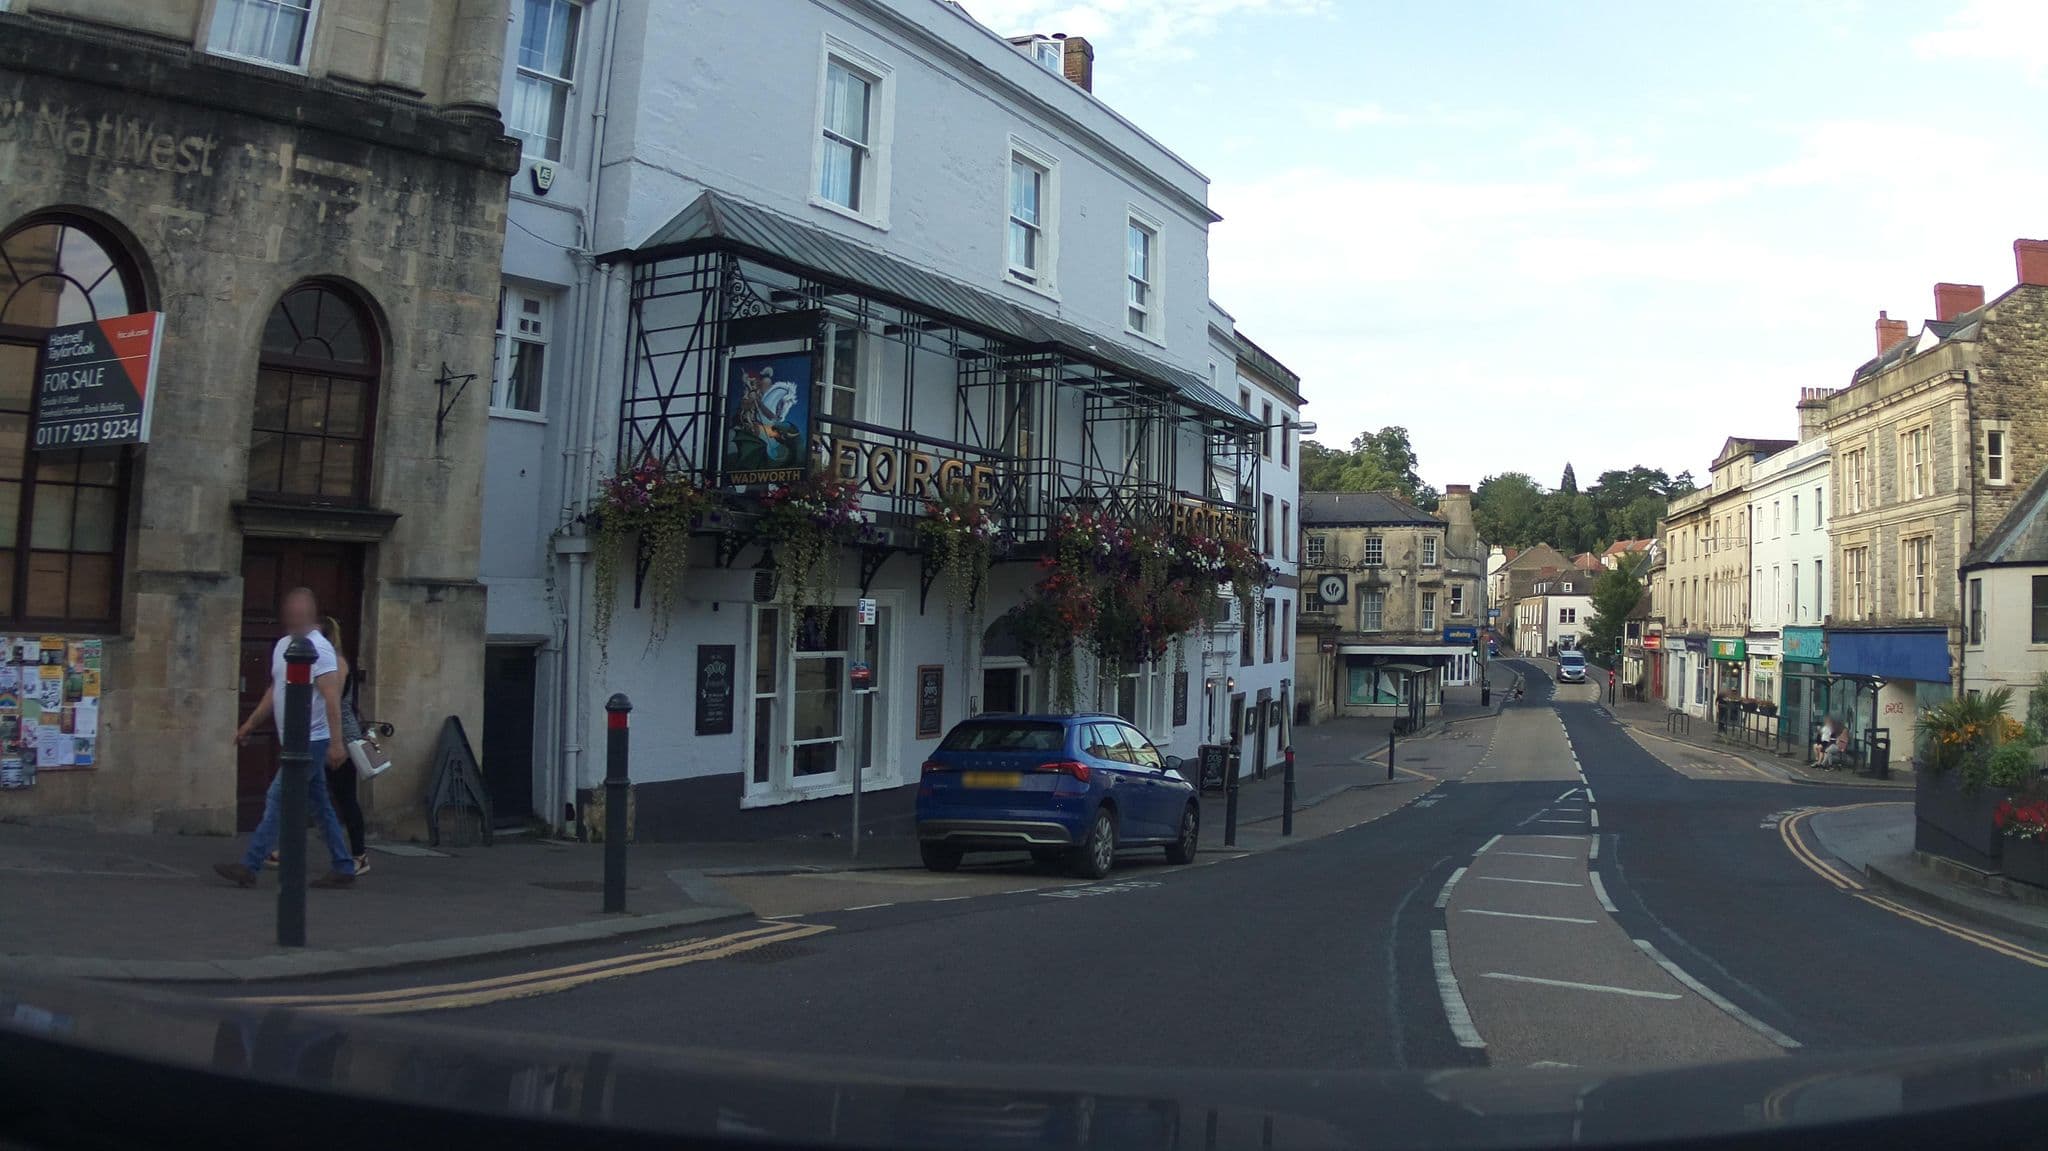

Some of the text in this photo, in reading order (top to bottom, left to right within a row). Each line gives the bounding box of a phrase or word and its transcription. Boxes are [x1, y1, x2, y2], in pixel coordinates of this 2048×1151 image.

[34, 100, 217, 177] NatWest
[43, 367, 105, 392] FOR SALE
[37, 420, 138, 444] 0117 923 9234
[731, 470, 801, 485] WADWORTH
